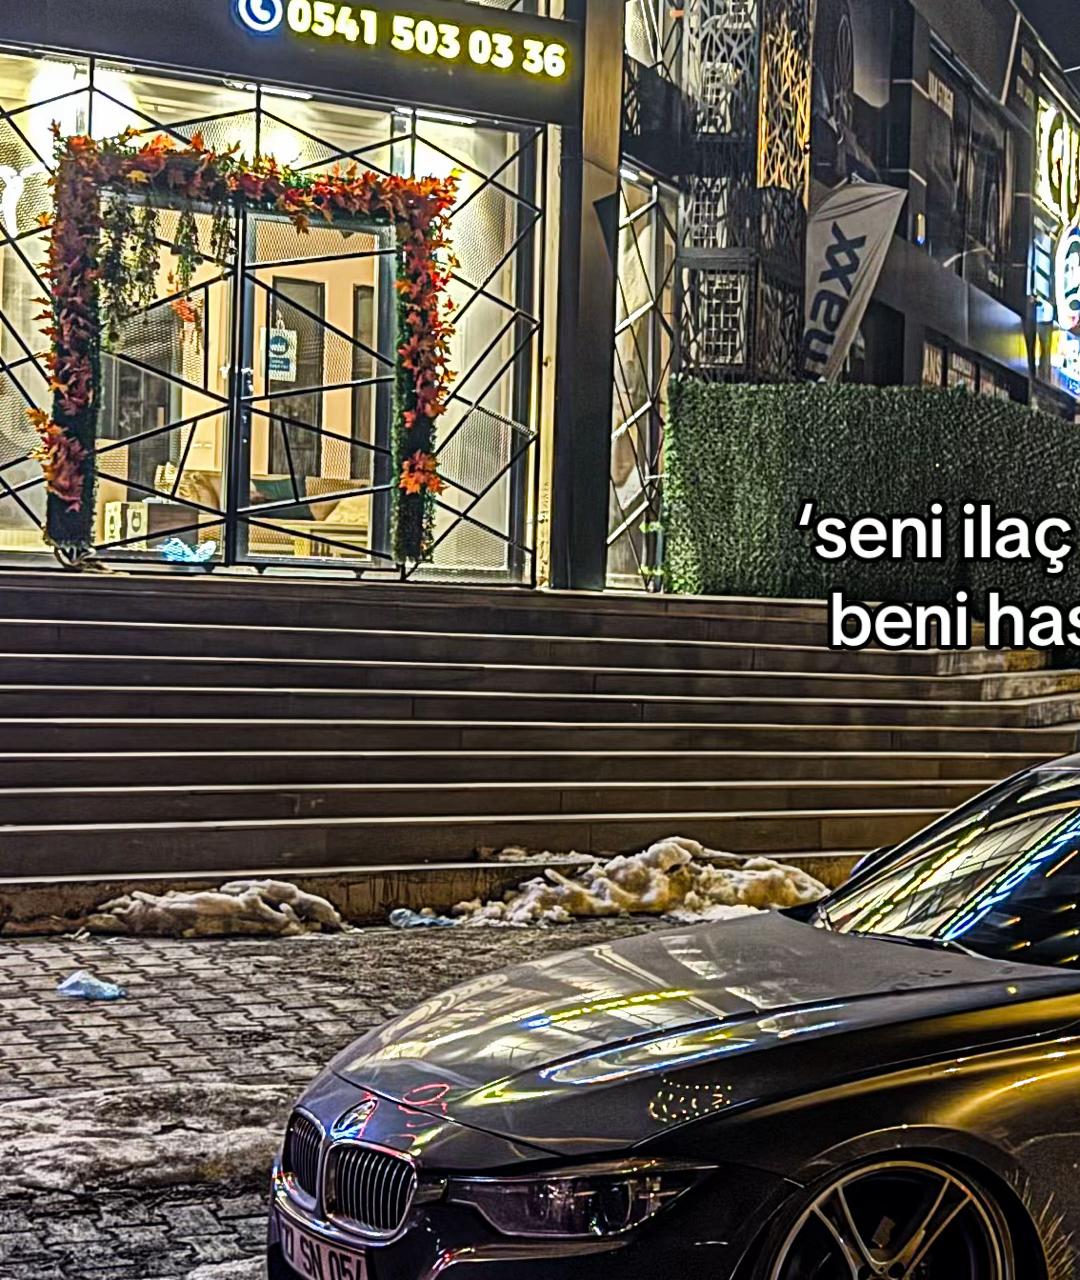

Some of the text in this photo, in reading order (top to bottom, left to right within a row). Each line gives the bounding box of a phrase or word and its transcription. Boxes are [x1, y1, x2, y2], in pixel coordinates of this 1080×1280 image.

[390, 15, 461, 60] 503
[468, 29, 515, 69] 03
[521, 39, 567, 78] 36
